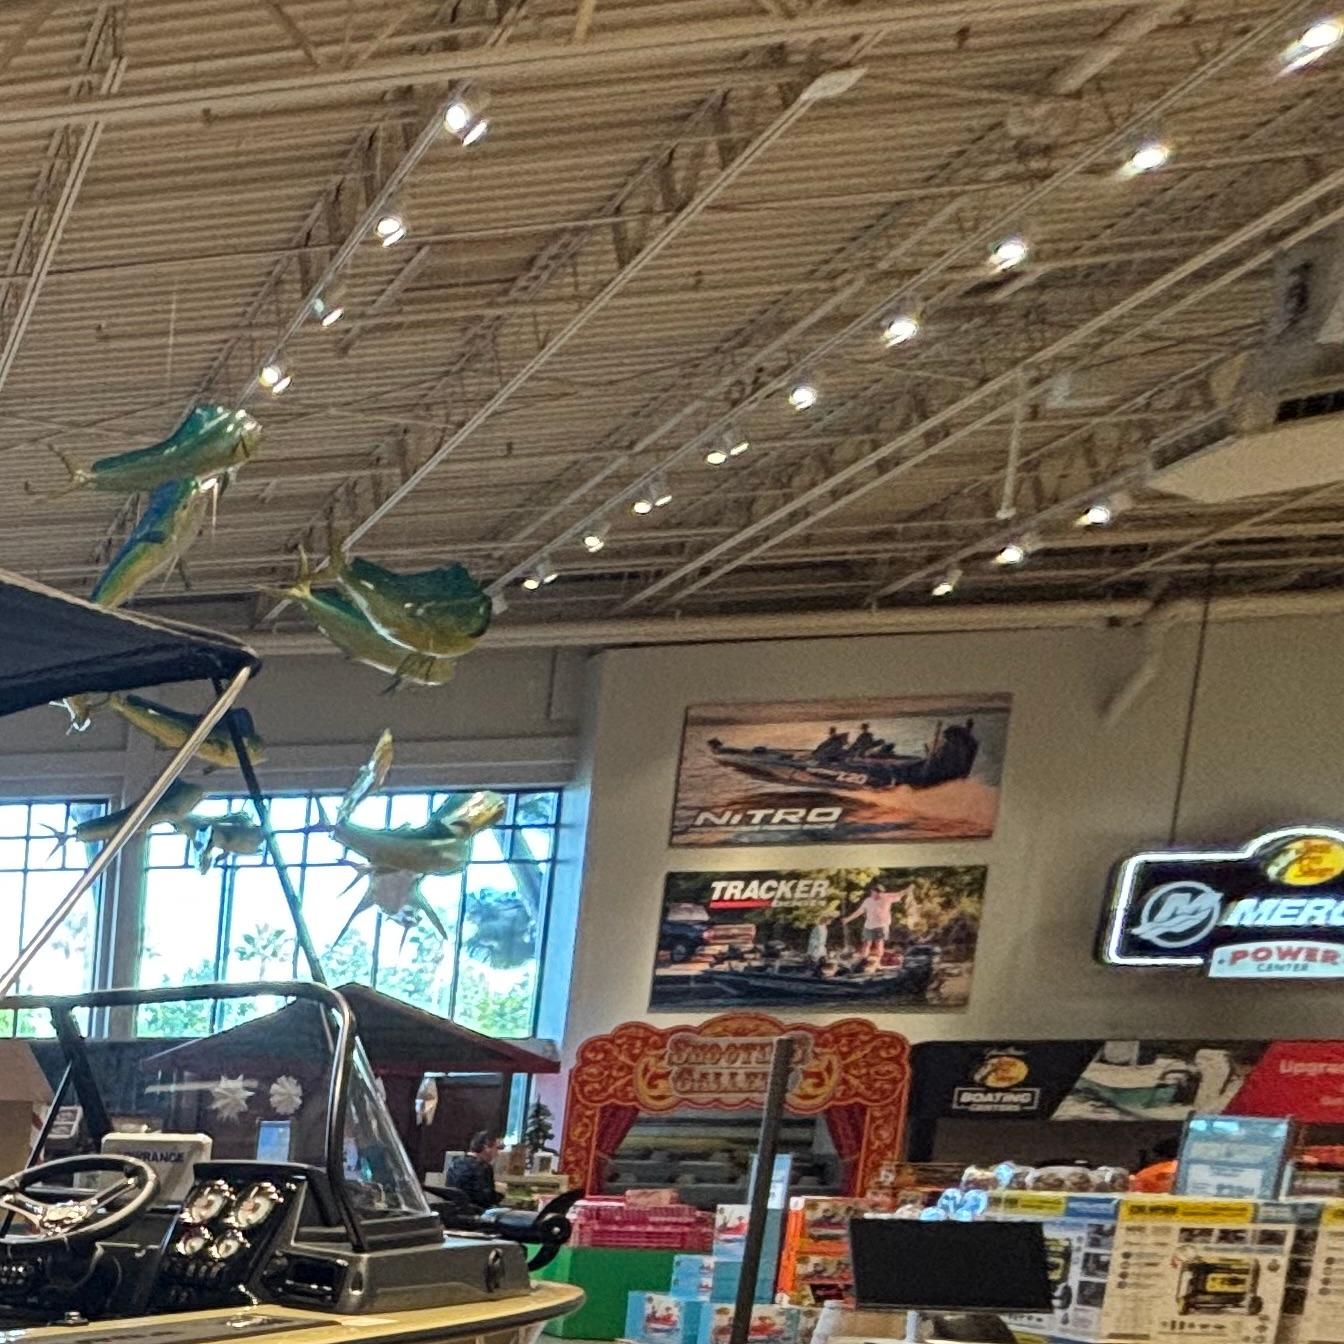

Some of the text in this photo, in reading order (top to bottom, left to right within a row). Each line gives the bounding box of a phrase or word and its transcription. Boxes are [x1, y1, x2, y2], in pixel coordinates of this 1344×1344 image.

[711, 880, 831, 900] TRACKER
[1228, 947, 1340, 965] POWER
[1256, 963, 1309, 973] CENTER
